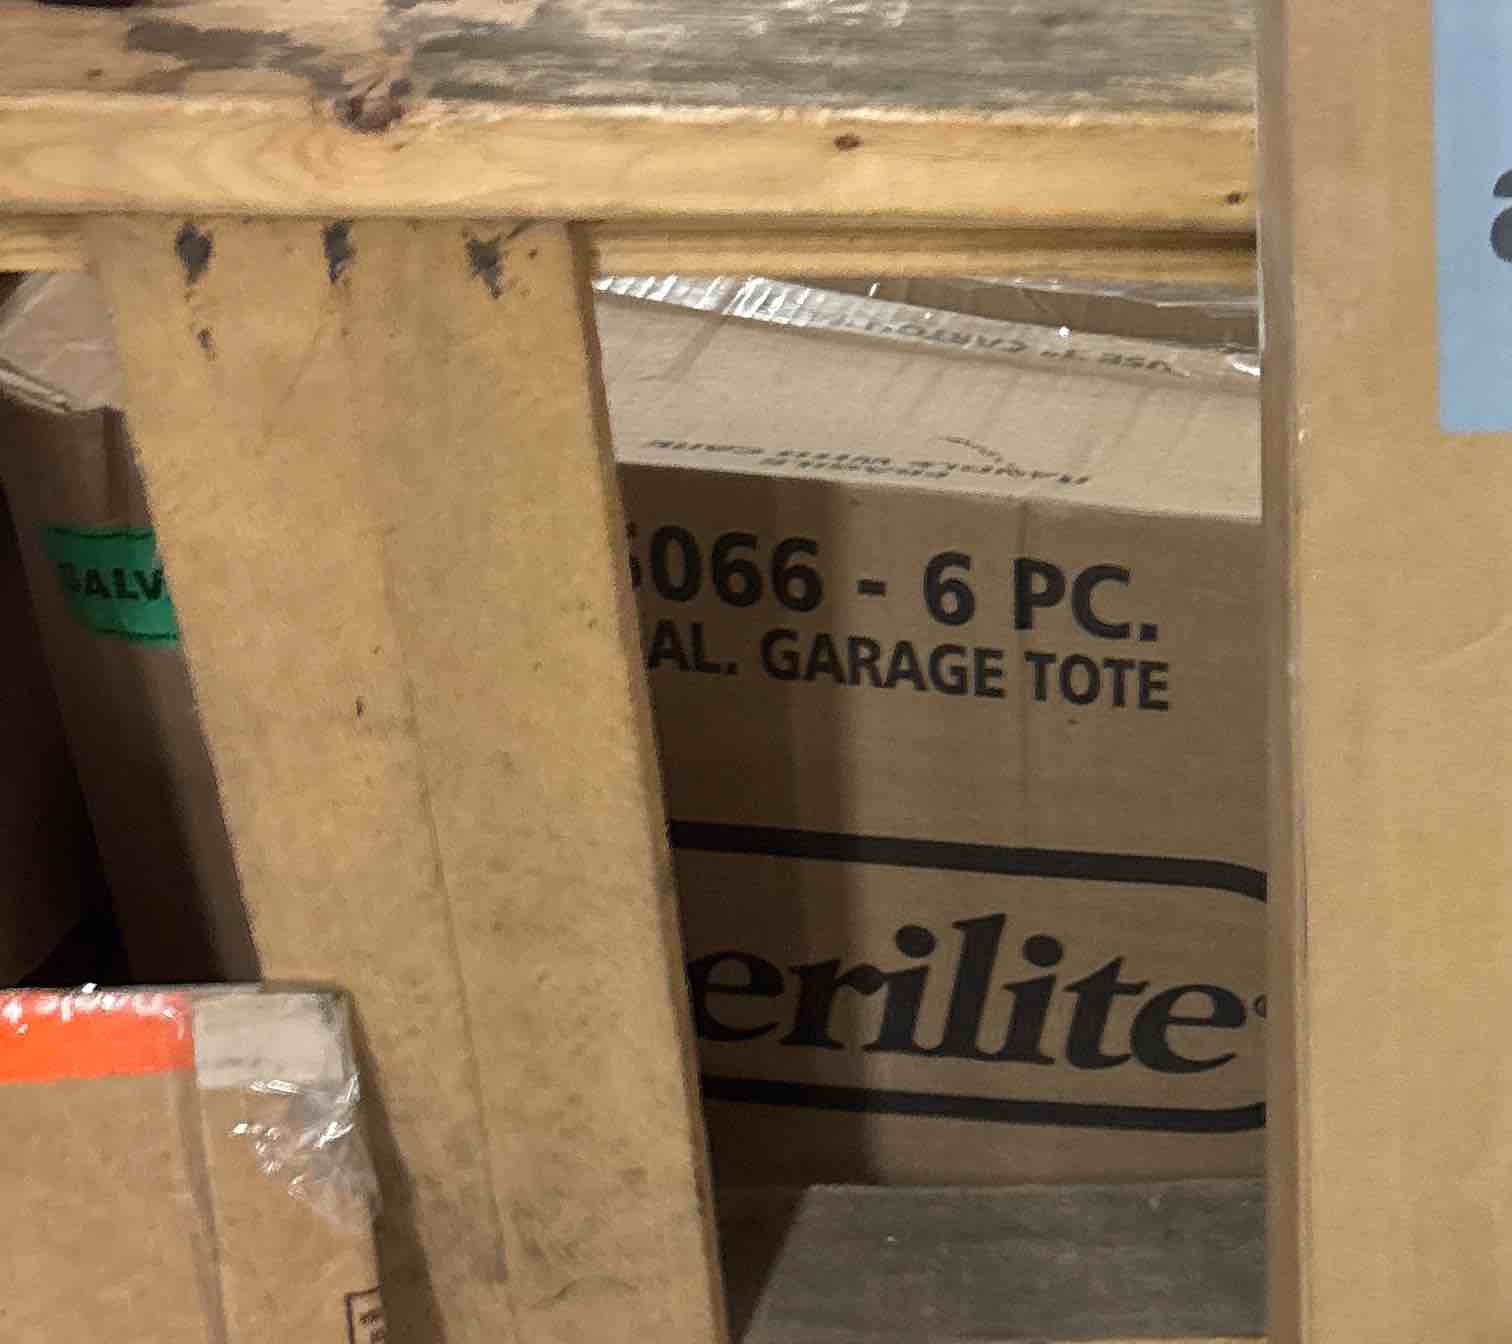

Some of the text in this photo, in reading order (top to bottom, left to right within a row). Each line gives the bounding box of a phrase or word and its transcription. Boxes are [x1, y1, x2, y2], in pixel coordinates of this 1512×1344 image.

[628, 522, 823, 613] 066
[921, 552, 977, 627] 6
[1012, 556, 1160, 643] PC.
[643, 619, 1173, 713] AL. GARAGE TOTE
[685, 912, 1248, 1077] erilite
